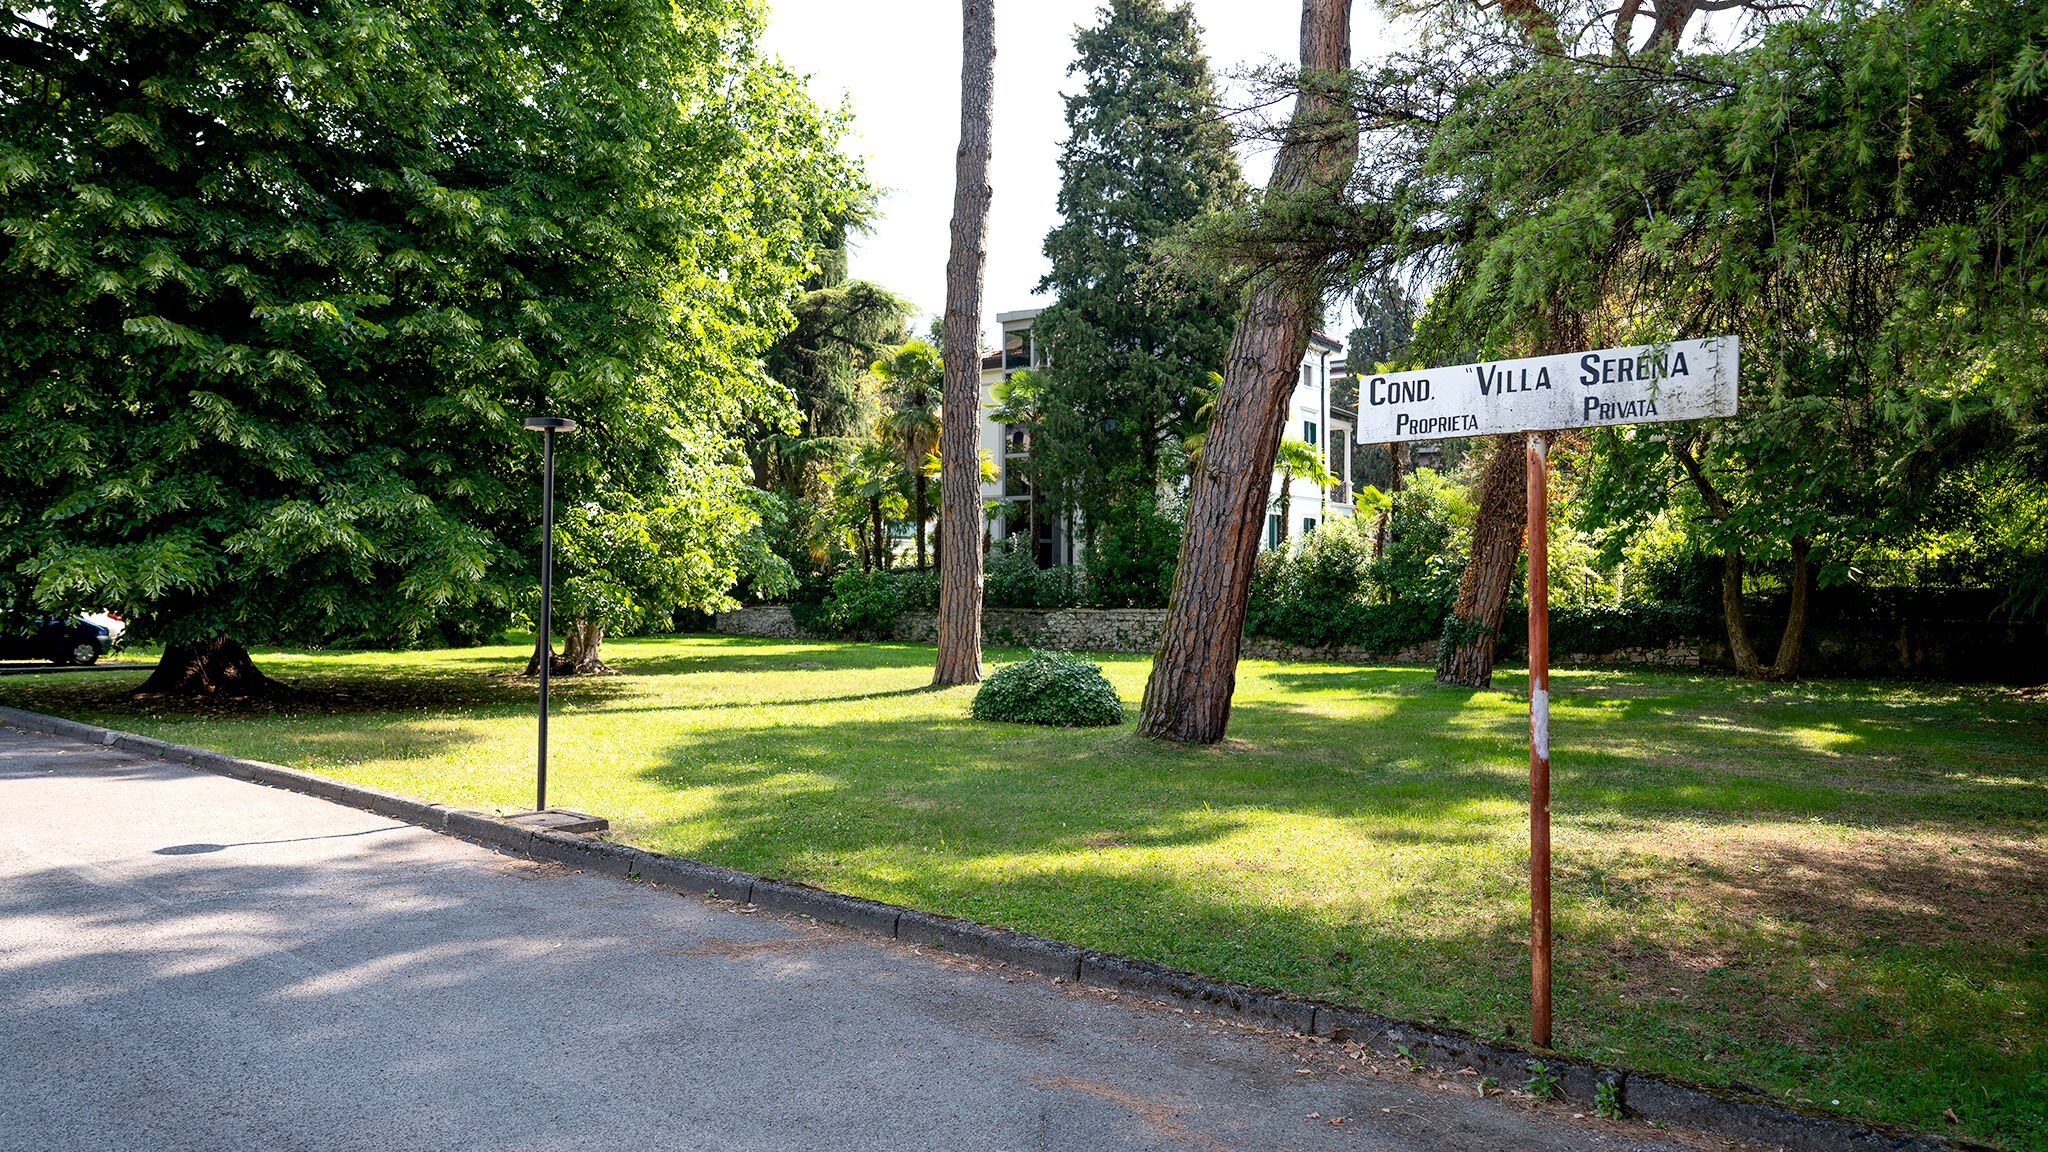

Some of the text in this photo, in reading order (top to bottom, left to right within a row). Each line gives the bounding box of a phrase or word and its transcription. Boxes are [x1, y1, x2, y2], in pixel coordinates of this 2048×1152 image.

[1370, 377, 1435, 406] COND.
[1396, 396, 1658, 435] PROPRIETA PRIVATA
